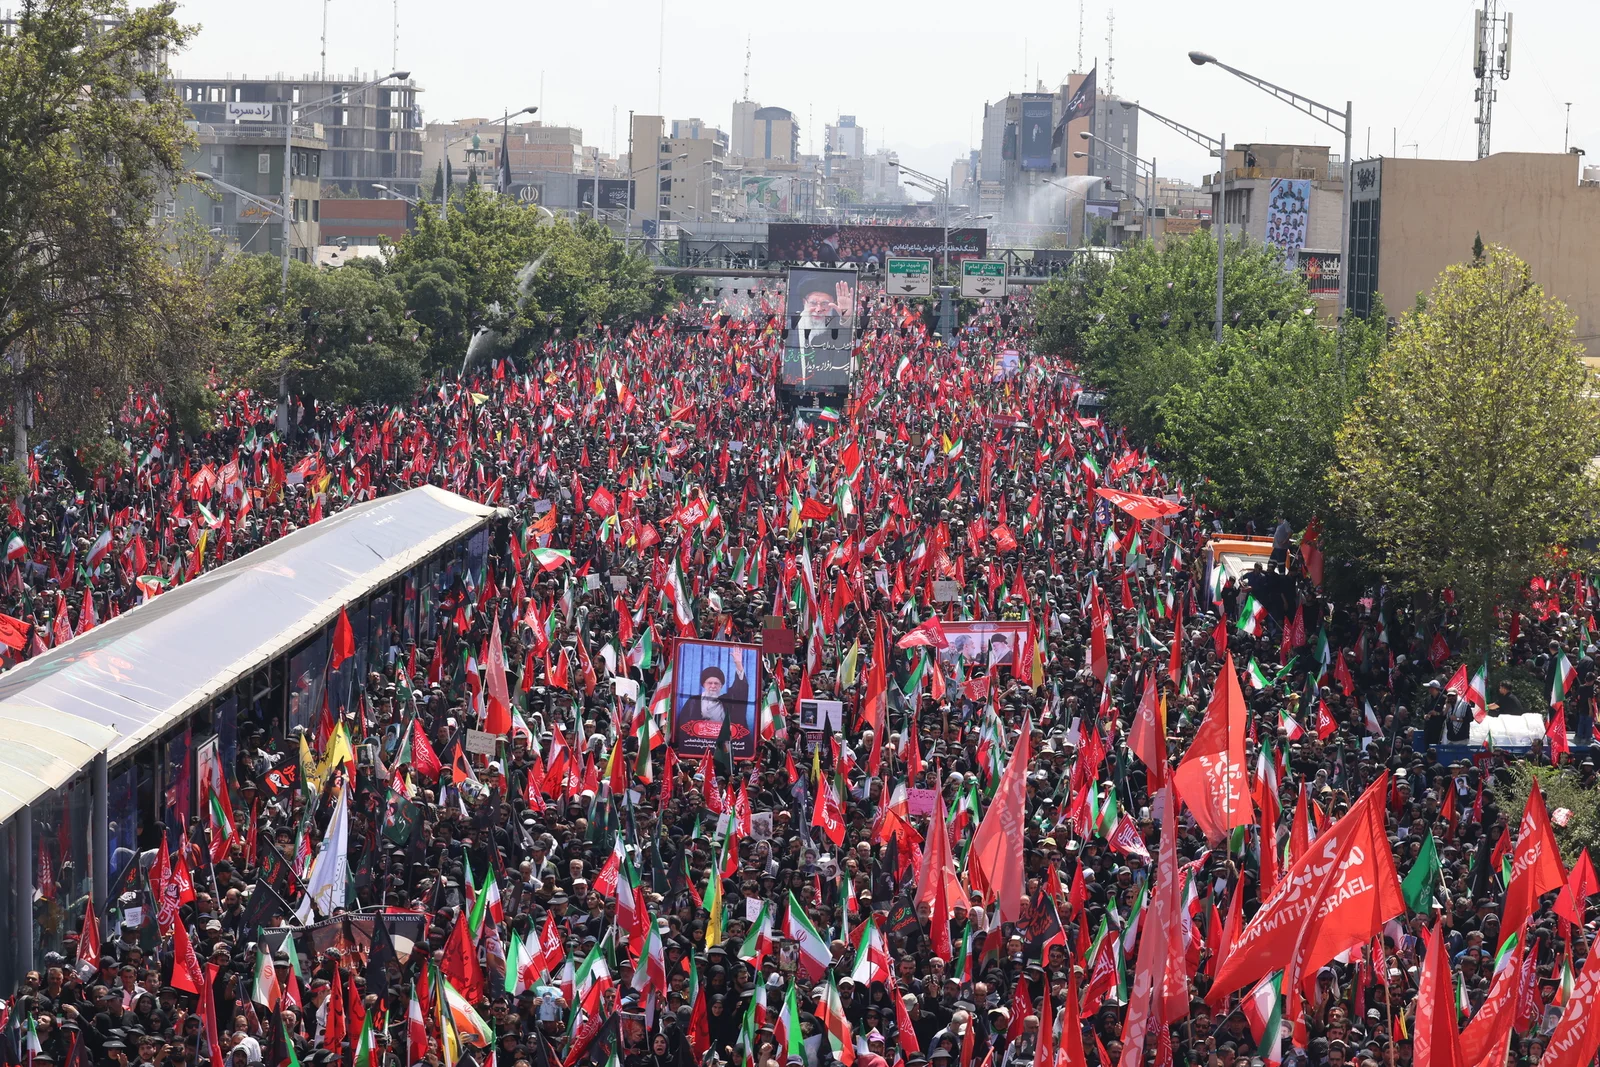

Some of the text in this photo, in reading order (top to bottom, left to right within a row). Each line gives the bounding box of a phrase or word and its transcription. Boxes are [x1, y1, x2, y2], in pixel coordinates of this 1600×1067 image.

[229, 104, 270, 119] راد سرما
[1510, 840, 1542, 883] ENGE
[1263, 897, 1311, 933] WITH
